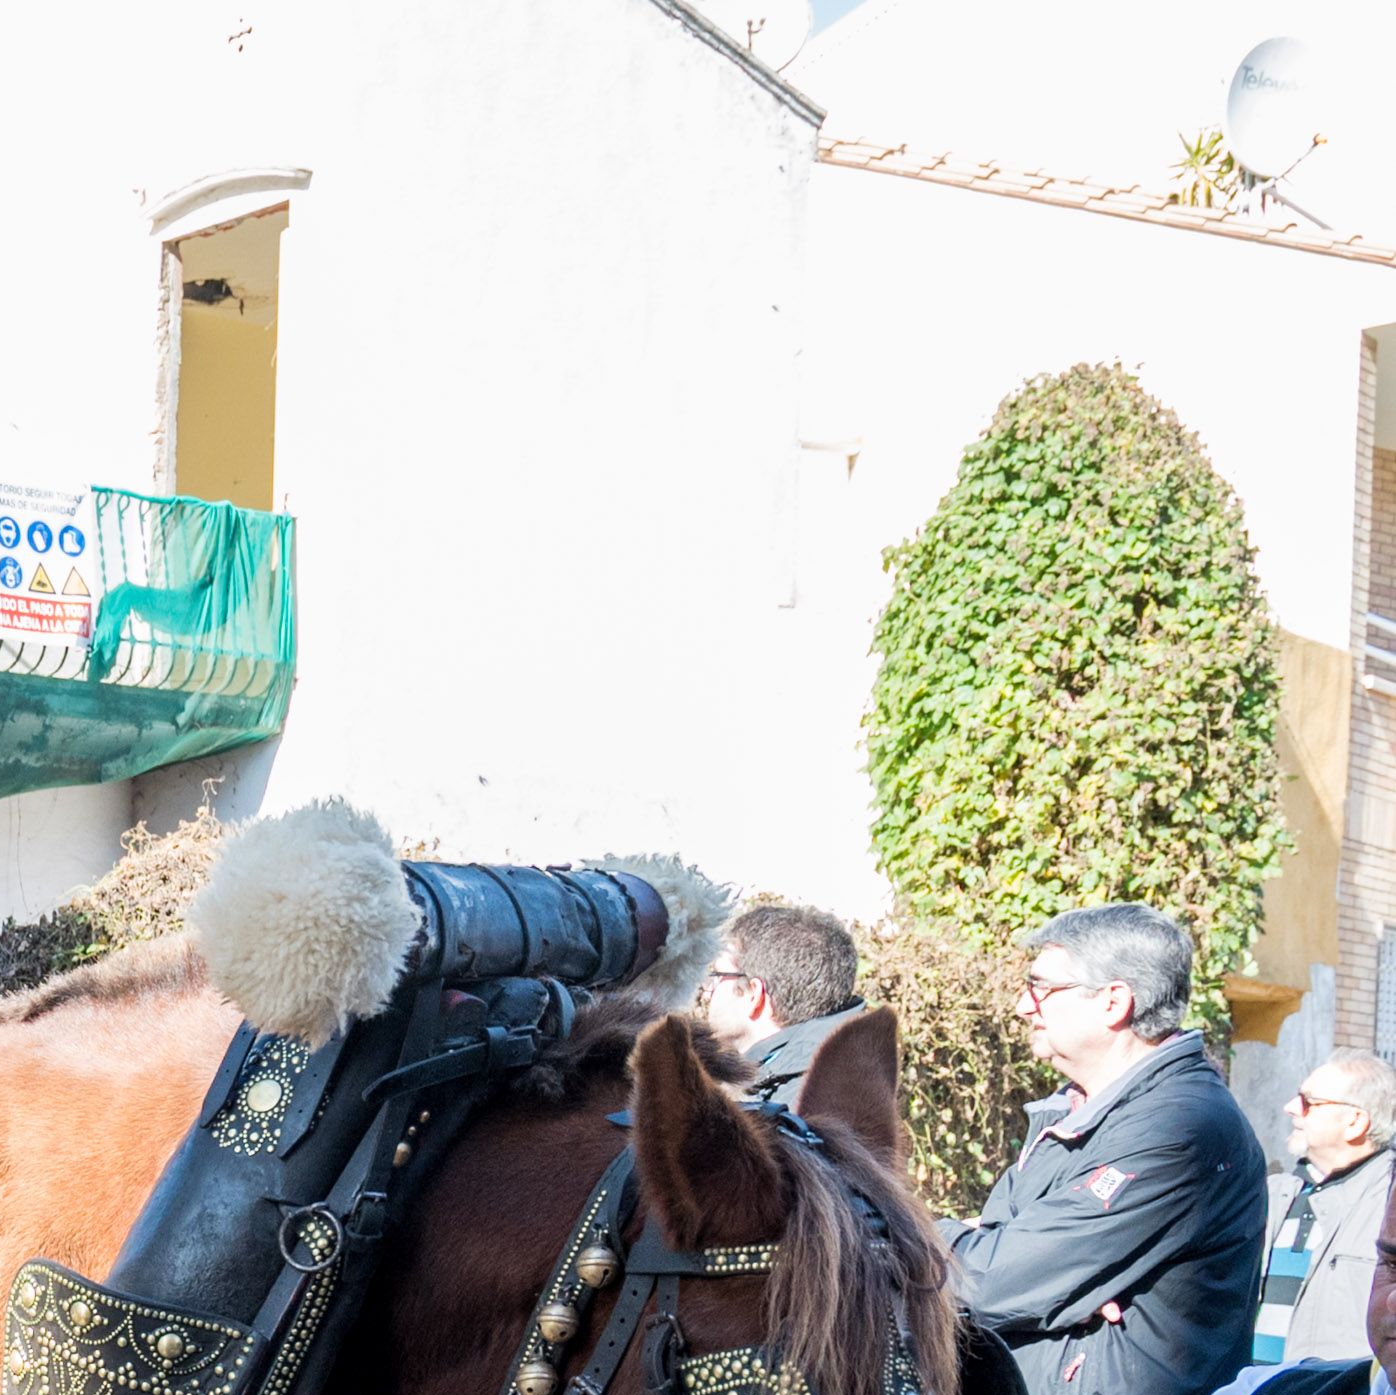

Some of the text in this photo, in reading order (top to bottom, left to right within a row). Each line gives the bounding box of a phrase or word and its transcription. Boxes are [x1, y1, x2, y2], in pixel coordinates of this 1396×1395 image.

[17, 599, 29, 613] EL
[29, 601, 54, 616] PASO
[54, 603, 64, 617] A
